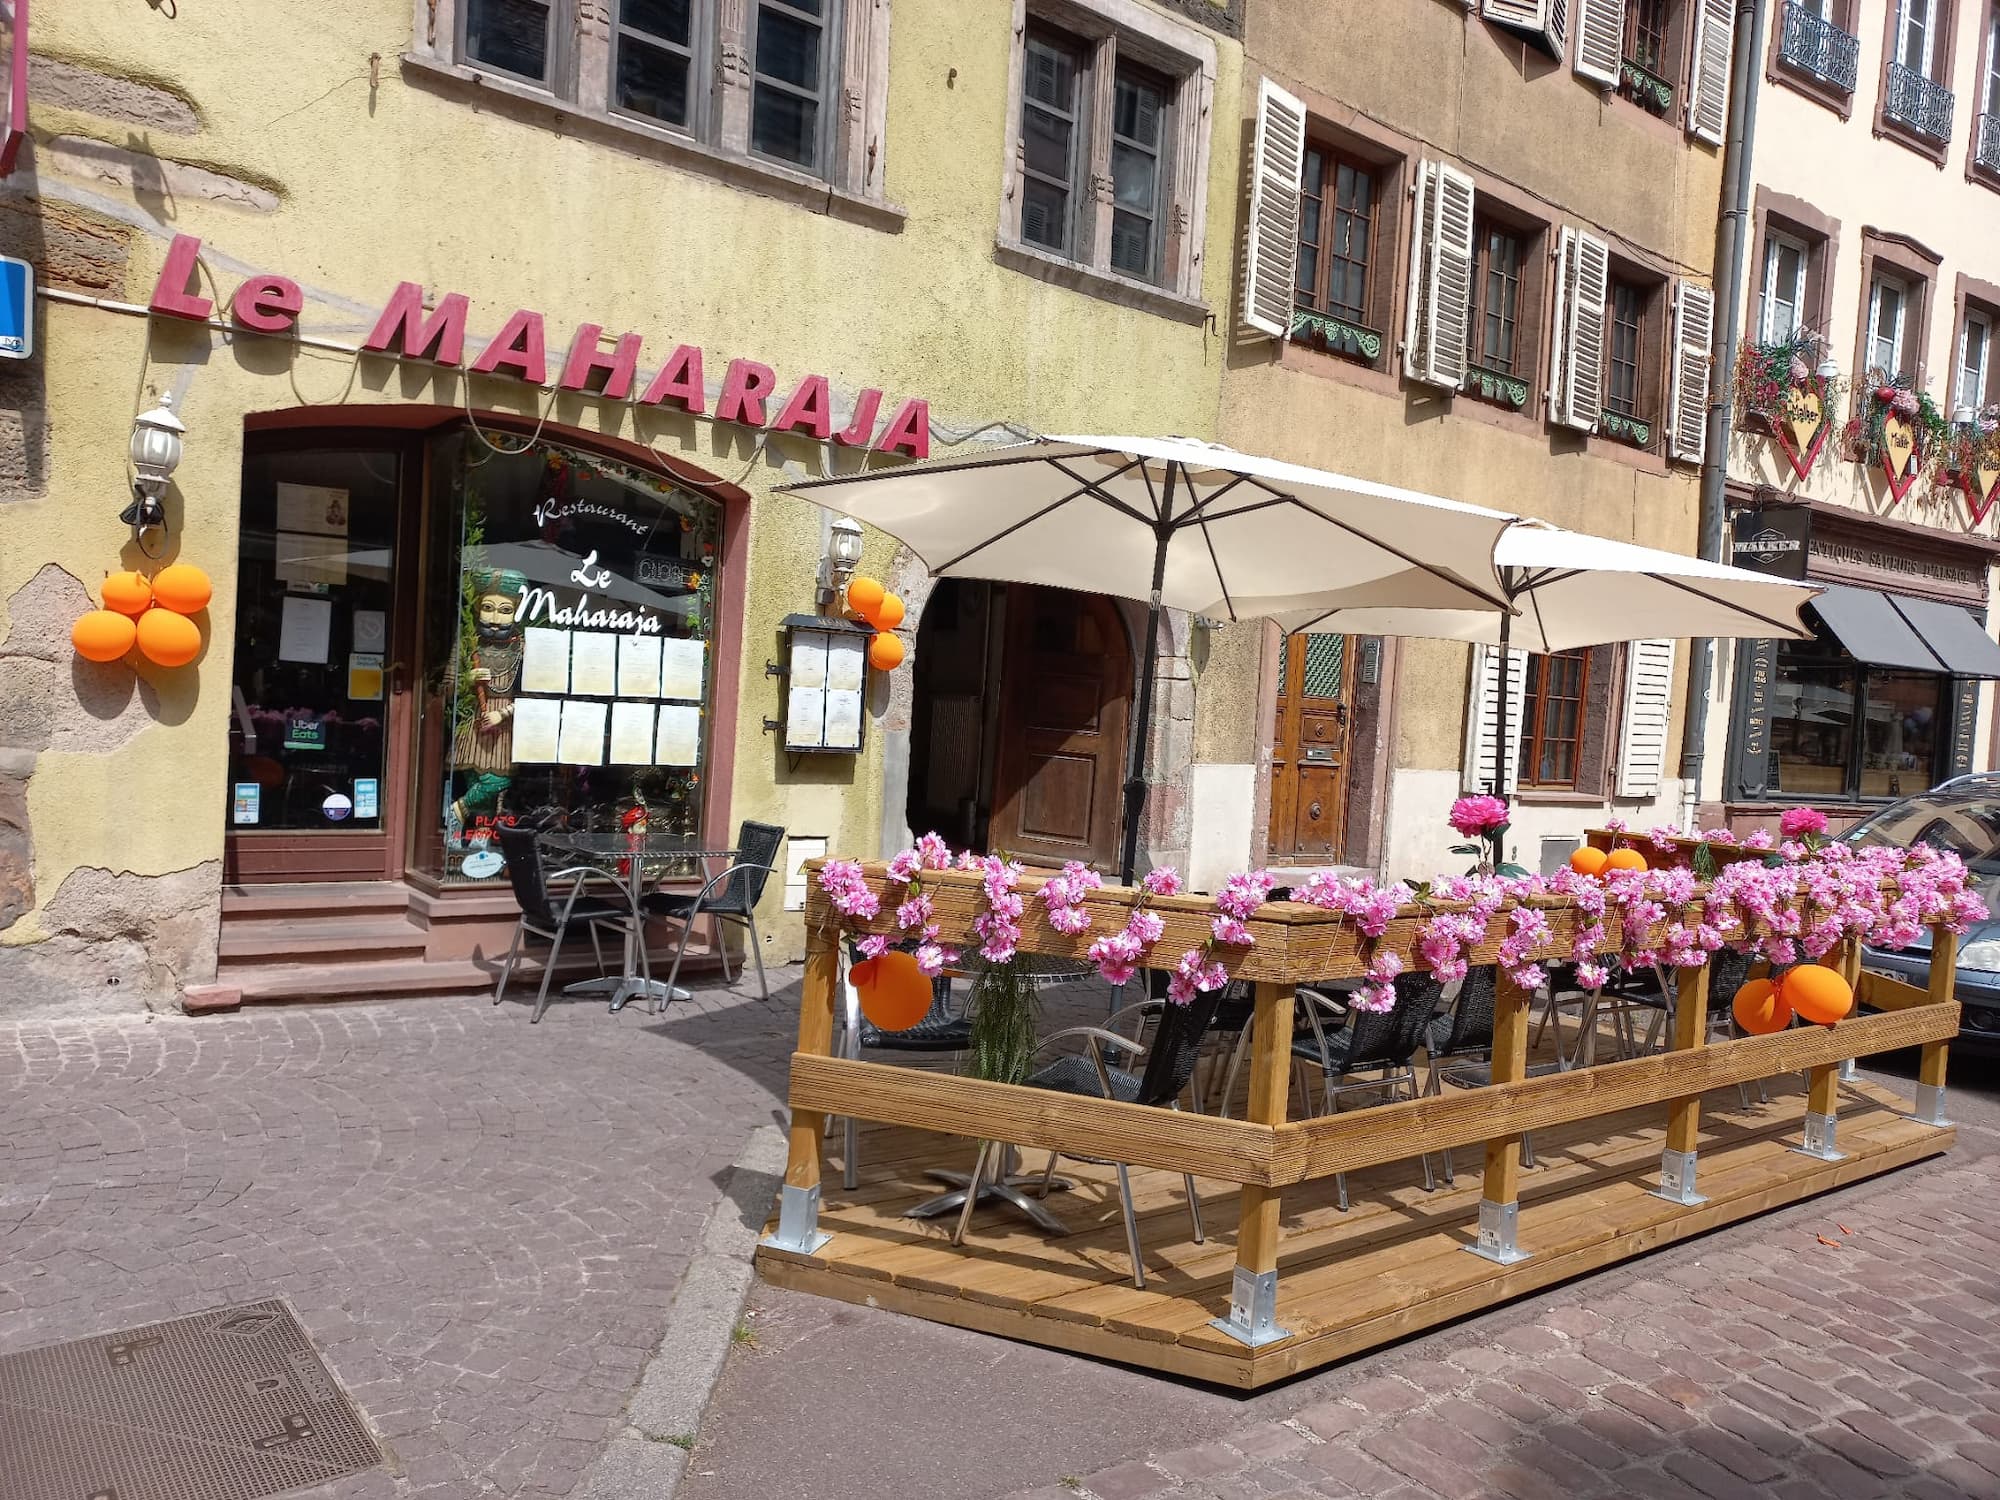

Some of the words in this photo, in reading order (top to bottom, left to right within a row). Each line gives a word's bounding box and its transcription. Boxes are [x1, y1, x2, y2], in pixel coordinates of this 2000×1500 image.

[150, 233, 304, 333] Le
[361, 280, 930, 459] MAHARAJA
[533, 498, 649, 536] Restaurant
[571, 549, 612, 589] Le
[1808, 539, 1865, 565] ENTIQUES
[1870, 551, 1919, 576] SAVEURS
[514, 585, 662, 646] Maharaja
[292, 729, 320, 739] Eats
[293, 719, 319, 730] Uber
